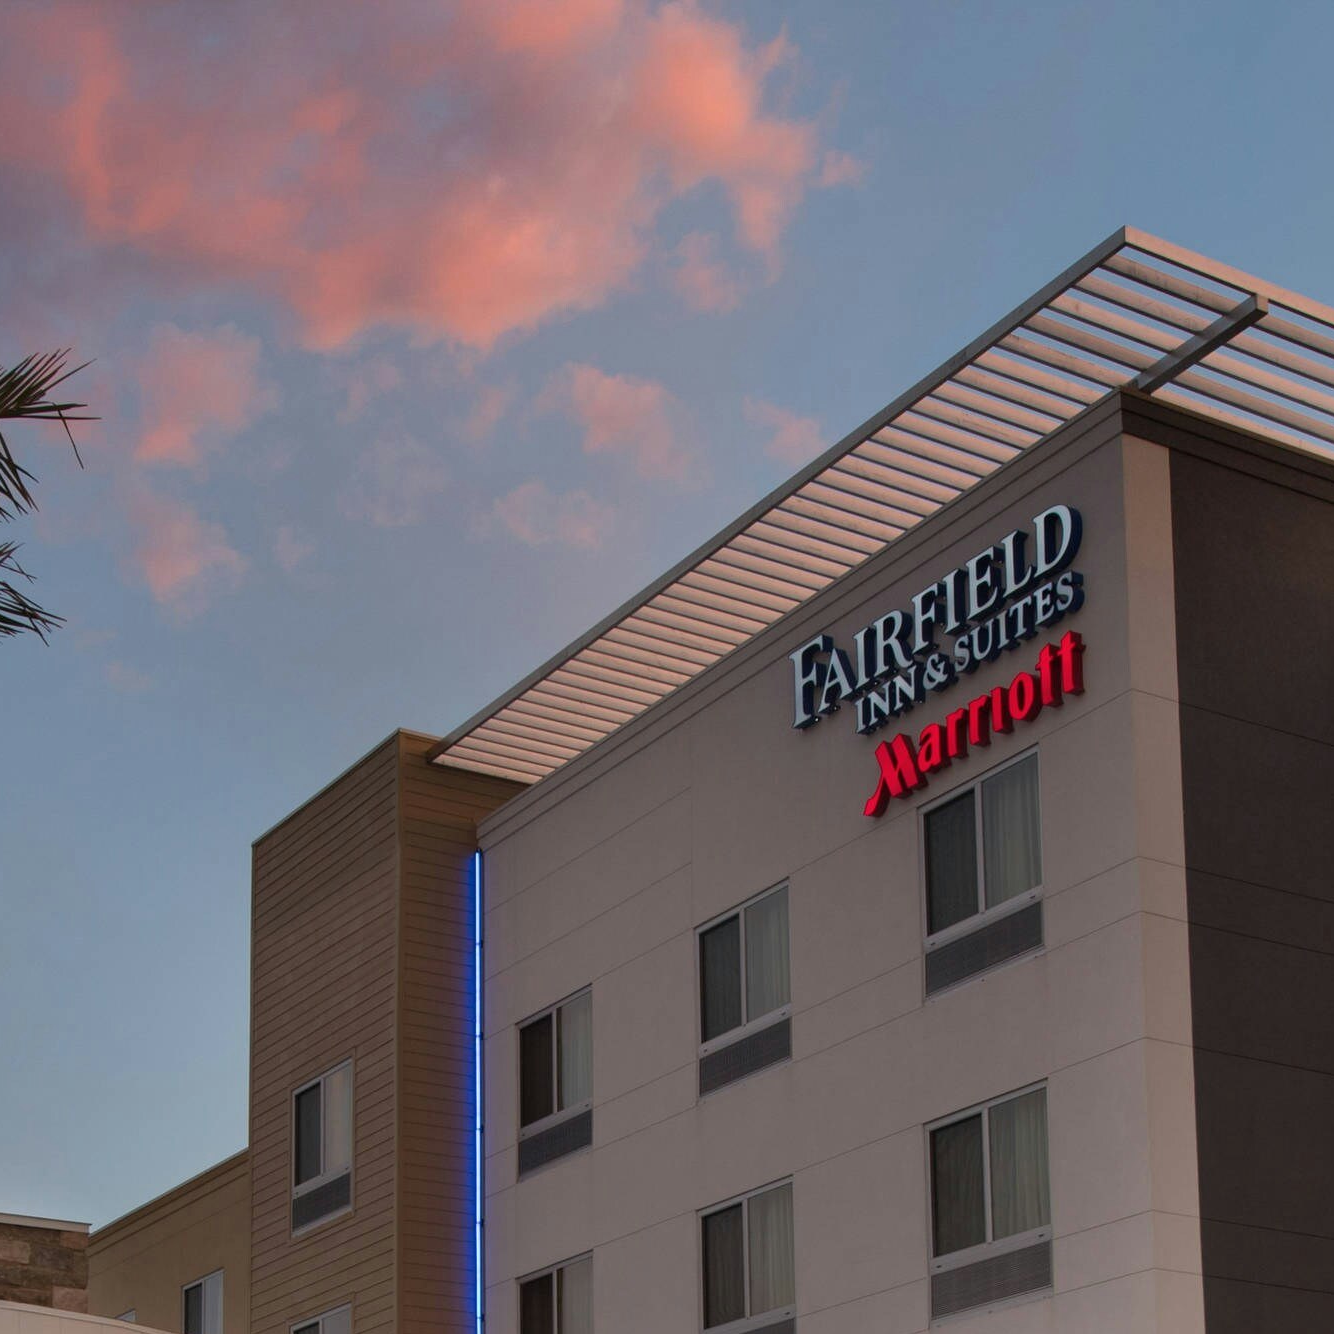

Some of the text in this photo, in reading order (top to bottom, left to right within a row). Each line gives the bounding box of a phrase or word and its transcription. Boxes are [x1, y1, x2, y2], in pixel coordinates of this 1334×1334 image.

[788, 504, 1083, 729] FAIRFIELD
[855, 570, 1084, 734] INN & SUITES
[863, 630, 1085, 816] Marriott
